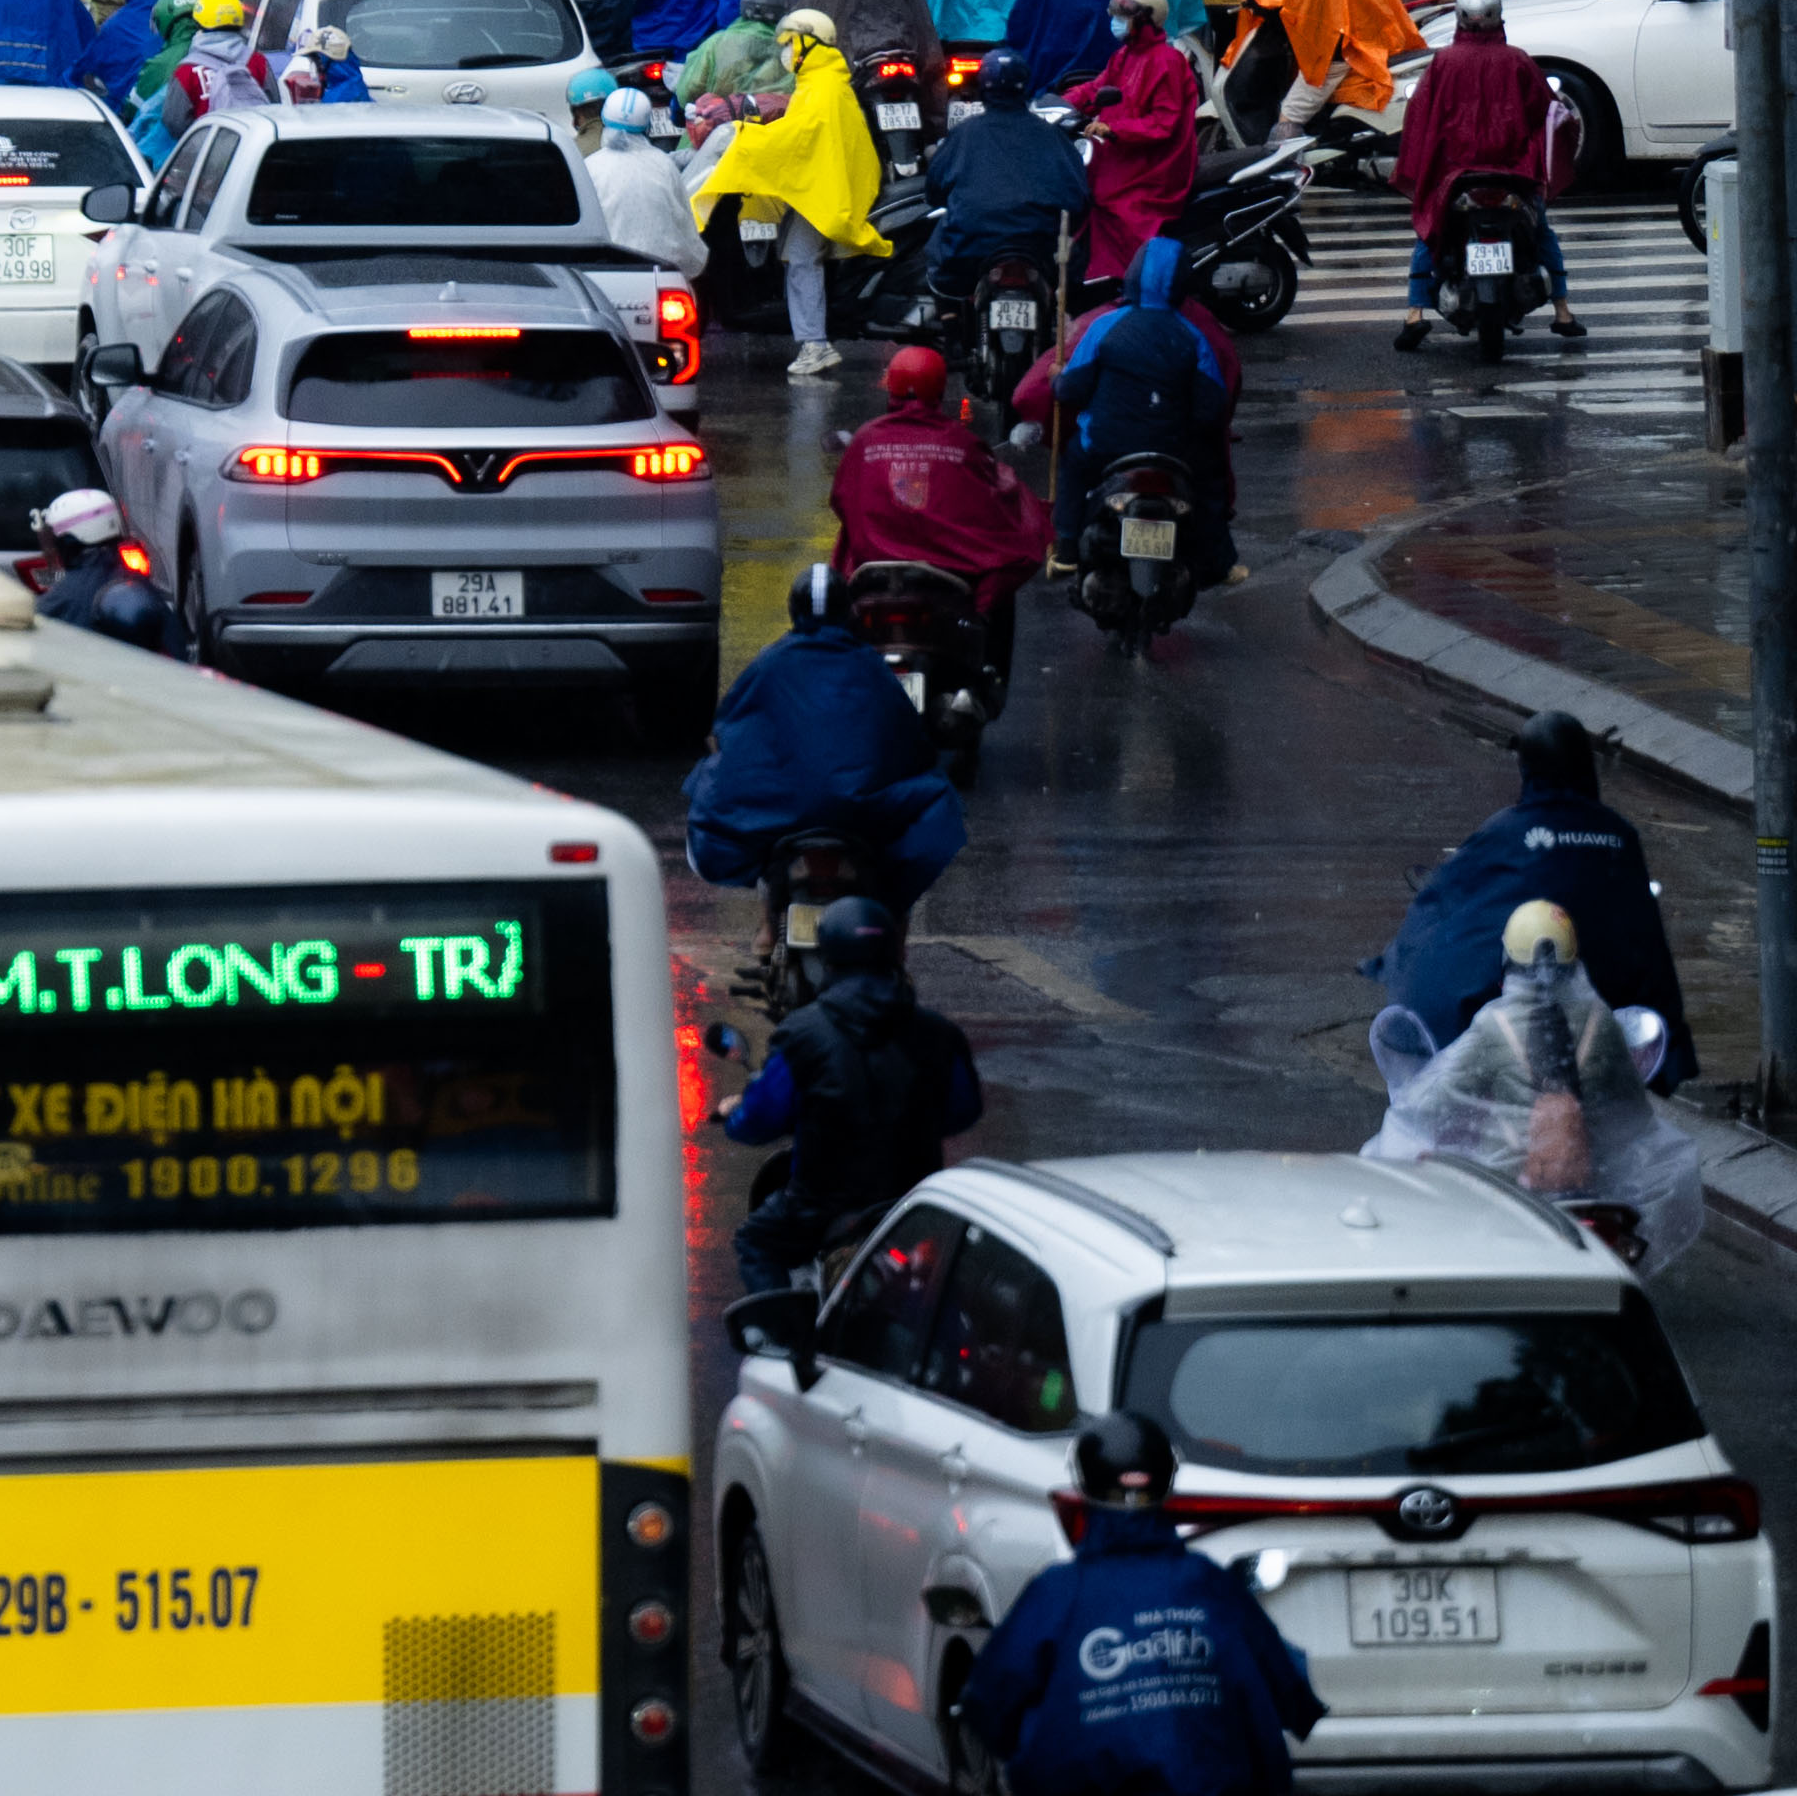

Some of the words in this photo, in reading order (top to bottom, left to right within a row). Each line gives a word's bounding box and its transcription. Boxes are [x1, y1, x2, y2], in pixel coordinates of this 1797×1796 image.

[4, 237, 37, 258] 30F
[457, 574, 497, 593] 29A
[442, 596, 511, 615] 881.41
[1558, 832, 1621, 847] HUAWEI
[9, 1084, 73, 1138] XE
[216, 1072, 280, 1130] HÀ
[1393, 1568, 1456, 1603] 30K
[114, 1567, 263, 1631] 515.07
[1371, 1607, 1479, 1638] 109.51
